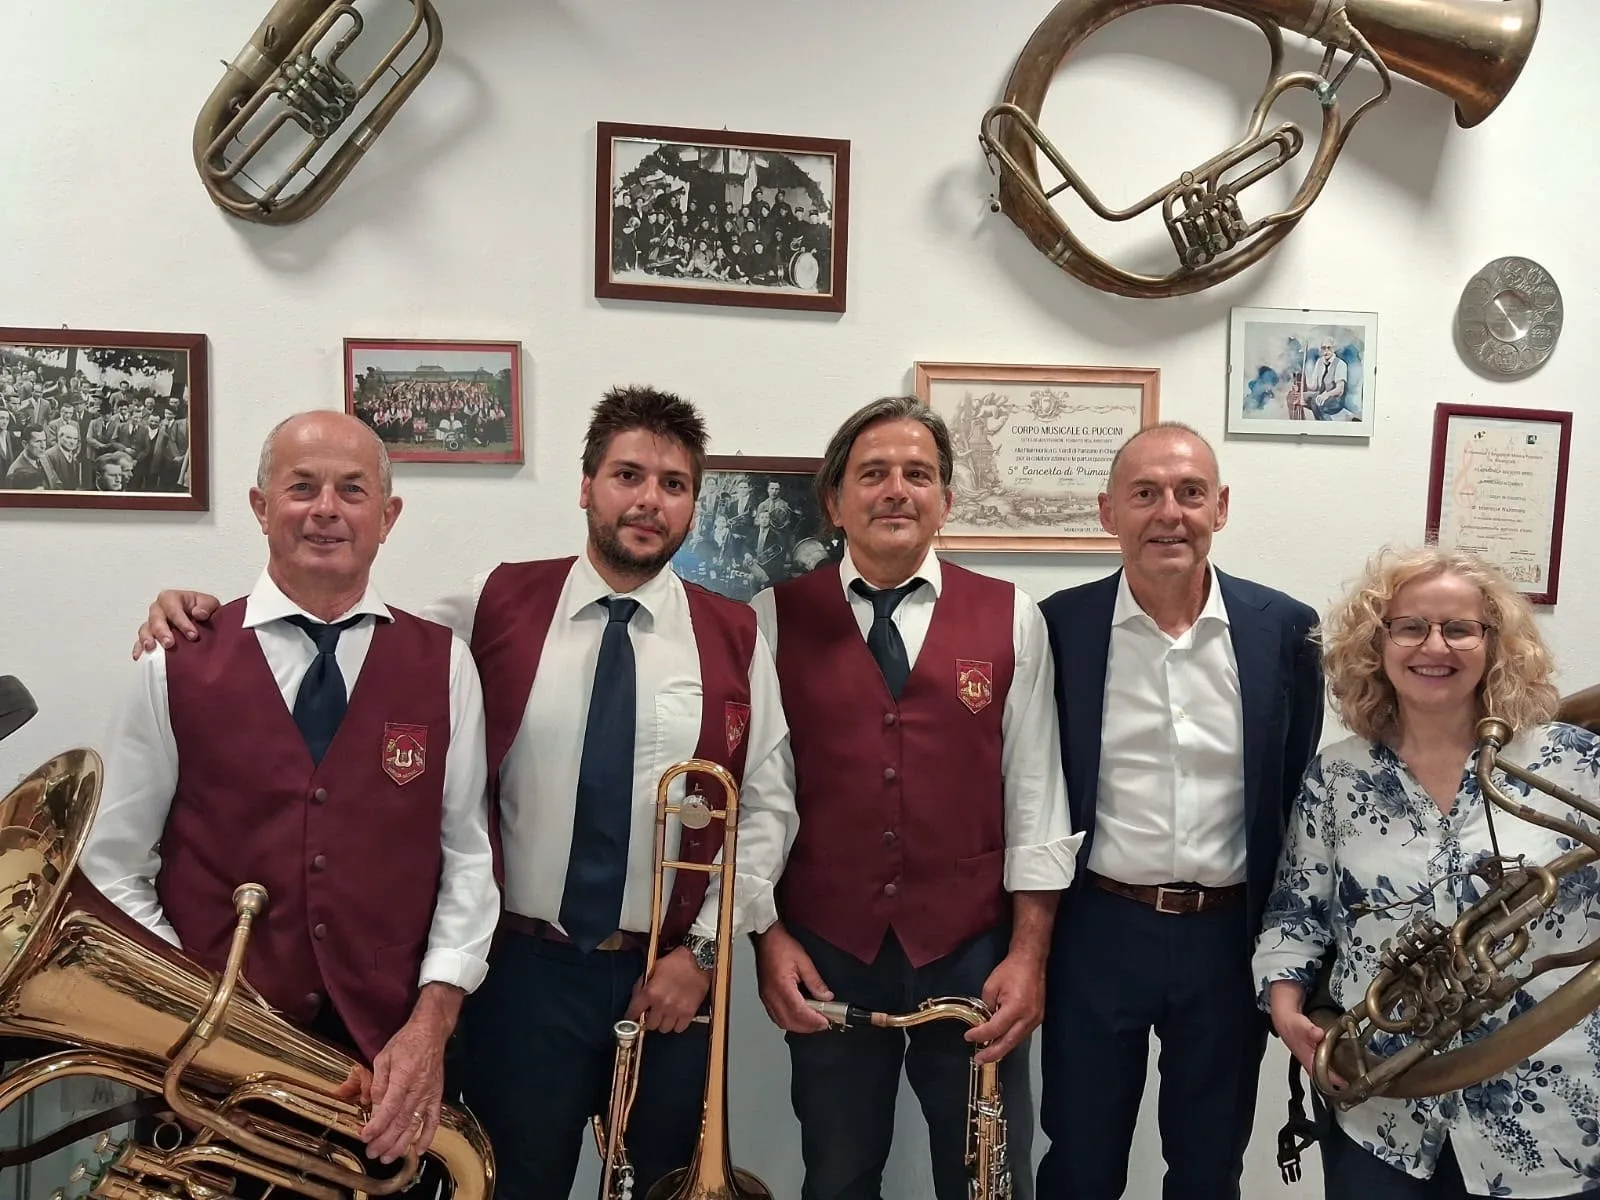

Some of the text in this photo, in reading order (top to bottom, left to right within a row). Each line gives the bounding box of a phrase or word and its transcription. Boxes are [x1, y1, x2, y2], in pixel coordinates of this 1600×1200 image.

[1011, 426, 1040, 435] CORPO
[1041, 426, 1081, 436] MUSICALE
[1092, 427, 1123, 436] PUCCINI
[1022, 465, 1062, 476] Concerto
[1064, 466, 1073, 476] di
